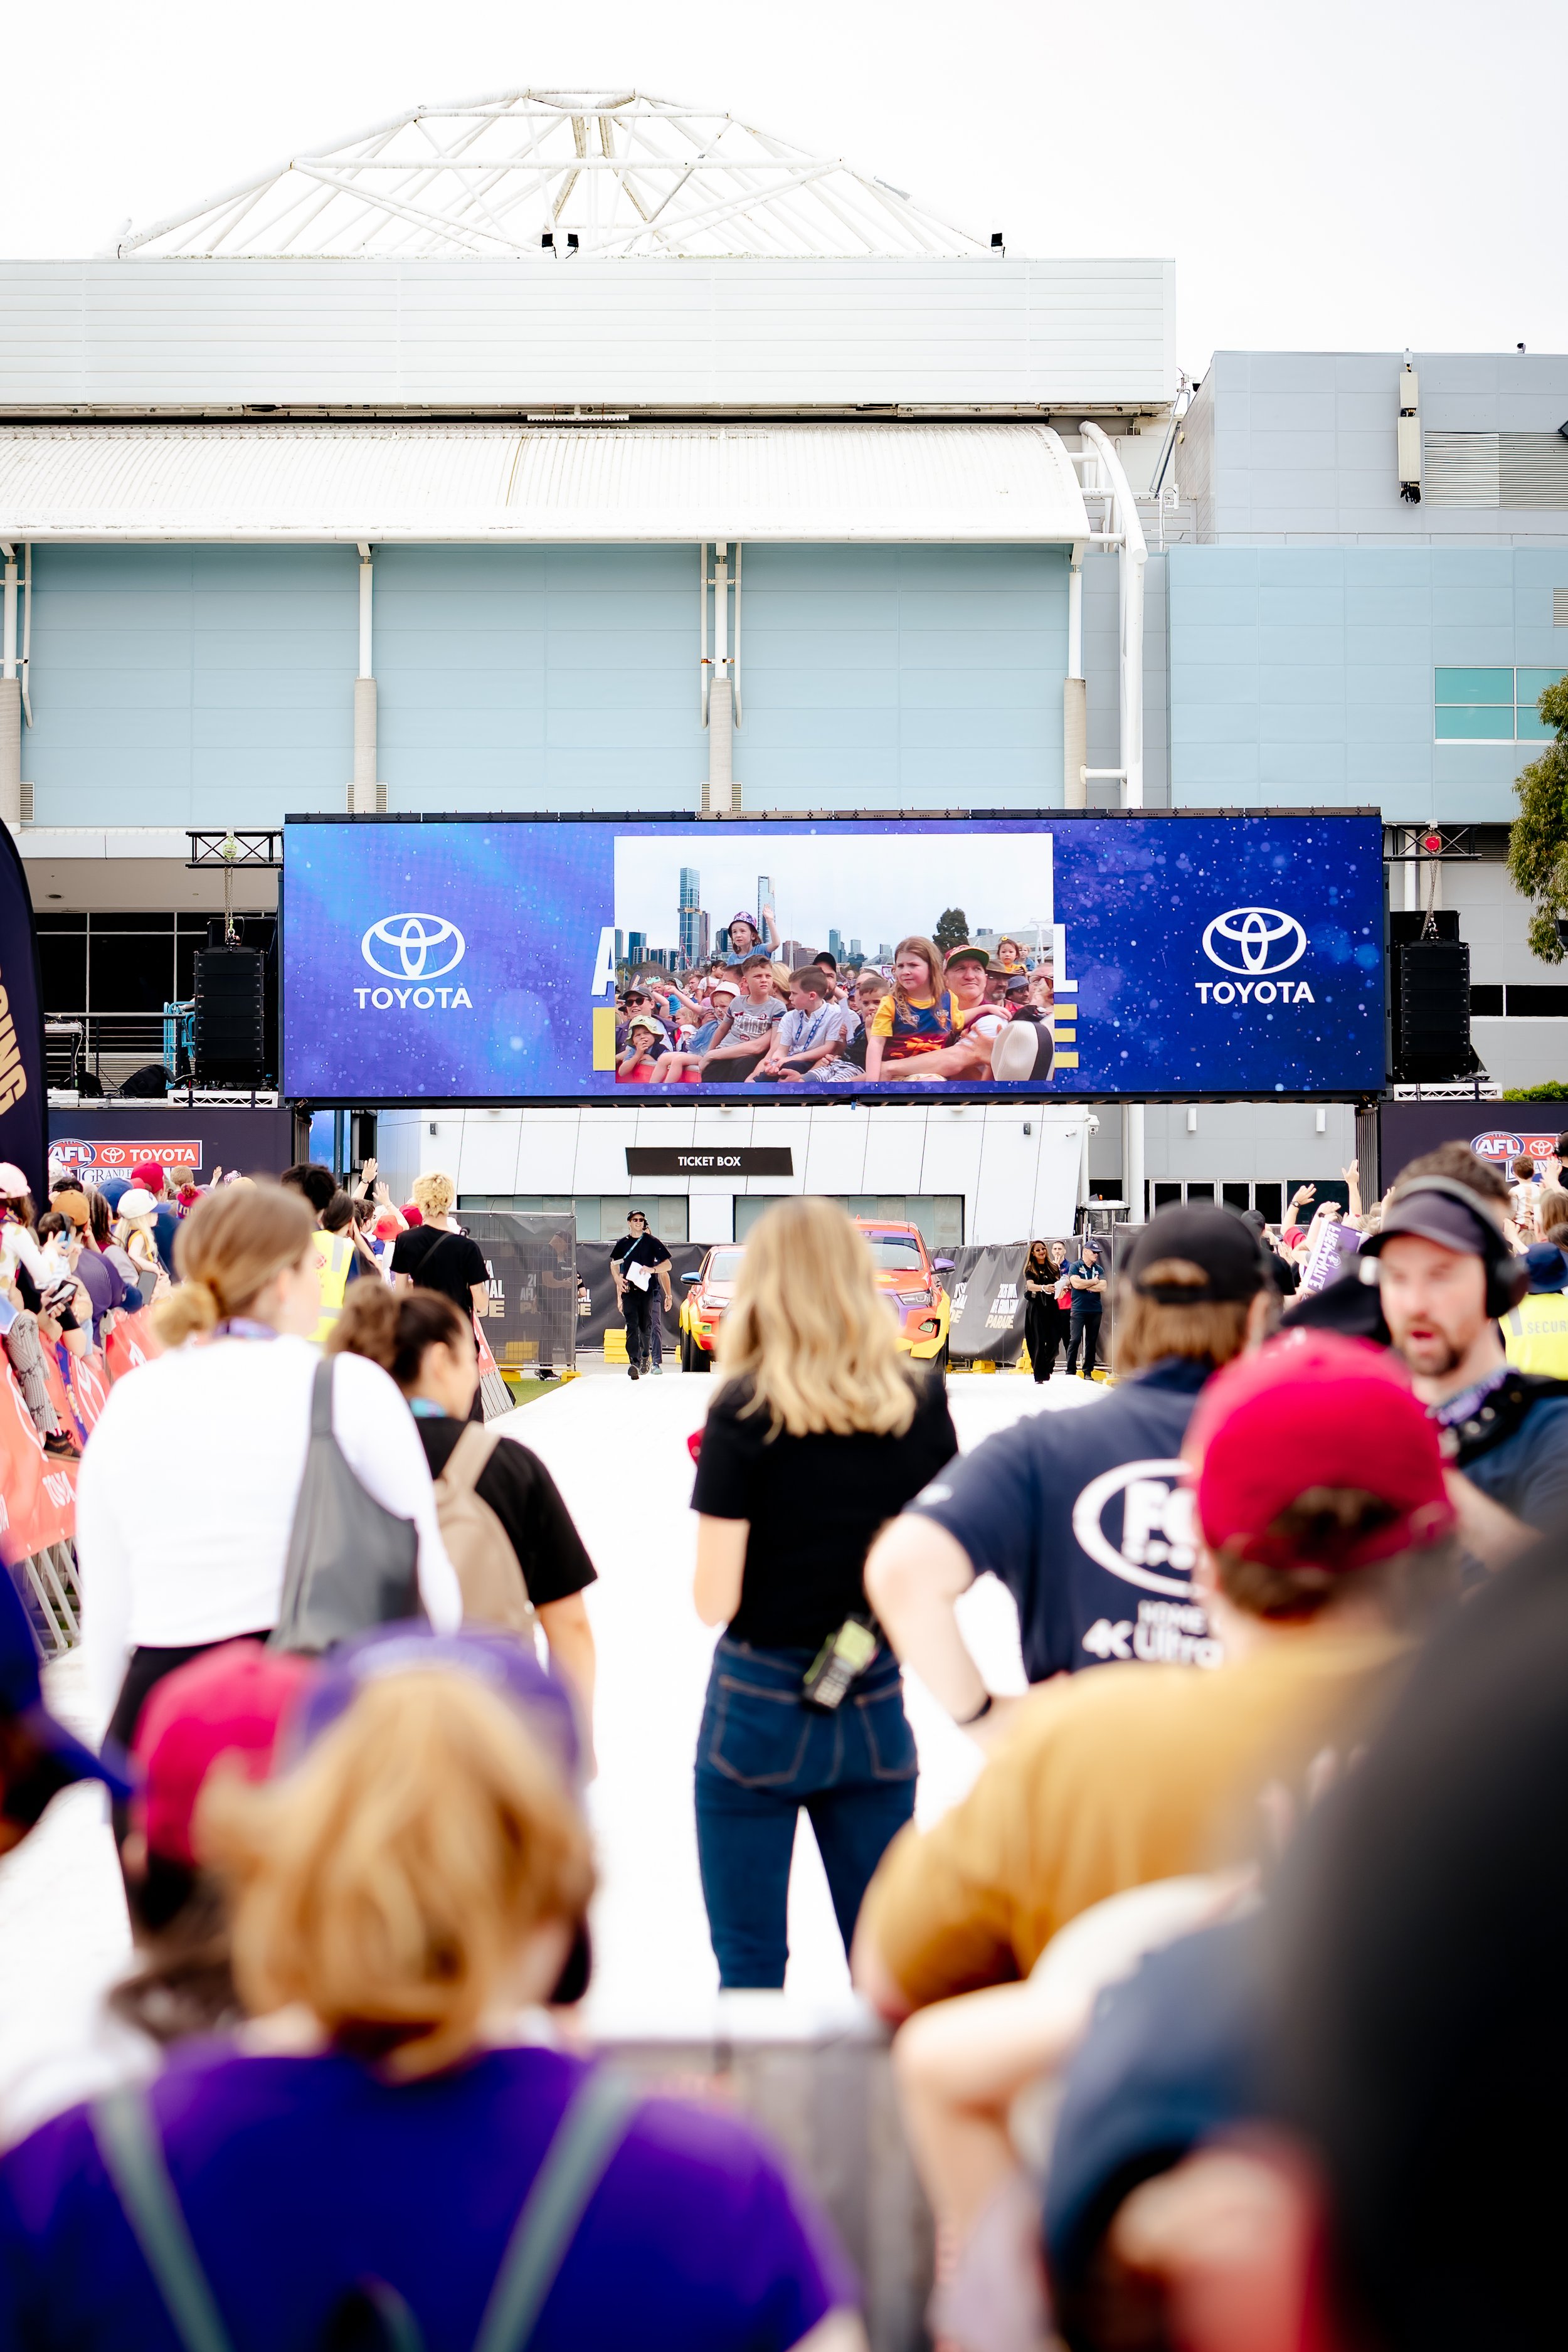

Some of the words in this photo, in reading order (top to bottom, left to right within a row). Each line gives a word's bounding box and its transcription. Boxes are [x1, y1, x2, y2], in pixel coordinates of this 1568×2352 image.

[353, 987, 474, 1010] TOYOTA
[1195, 981, 1315, 1004] TOYOTA
[49, 1146, 92, 1162] AFL
[129, 1148, 196, 1162] TOYOTA
[1475, 1139, 1521, 1155] AFL
[677, 1156, 714, 1167] TICKET
[717, 1156, 741, 1167] BOX
[82, 1168, 125, 1183] GRAND
[985, 1314, 1015, 1329] PARADE
[1081, 1618, 1133, 1659] 4K
